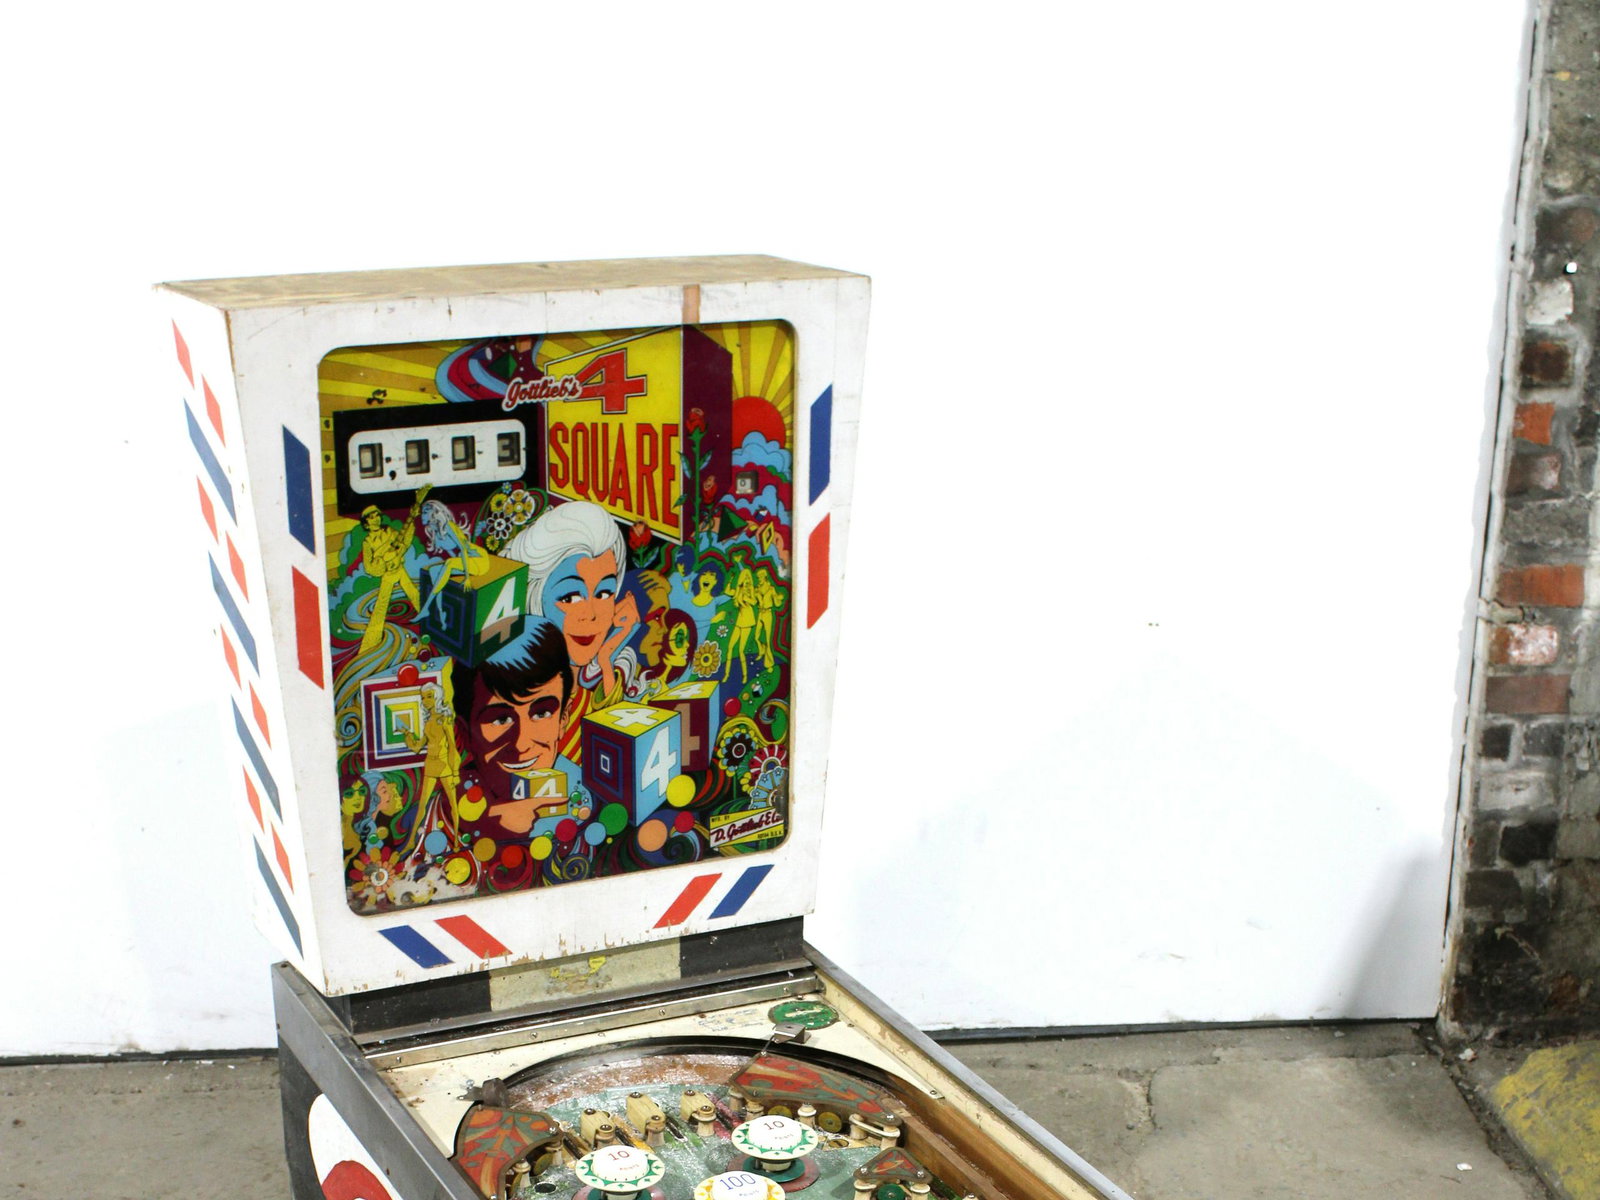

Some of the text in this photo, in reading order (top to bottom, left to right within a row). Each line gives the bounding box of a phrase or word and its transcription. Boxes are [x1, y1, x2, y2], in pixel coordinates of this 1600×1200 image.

[504, 376, 581, 410] Gottlieb's
[566, 348, 647, 414] 4
[550, 421, 680, 529] SQUARE
[480, 576, 520, 645] 4
[607, 707, 659, 728] 4
[640, 726, 677, 798] 4
[763, 1120, 785, 1131] 10
[607, 1150, 630, 1161] 10
[719, 1173, 757, 1191] 100
